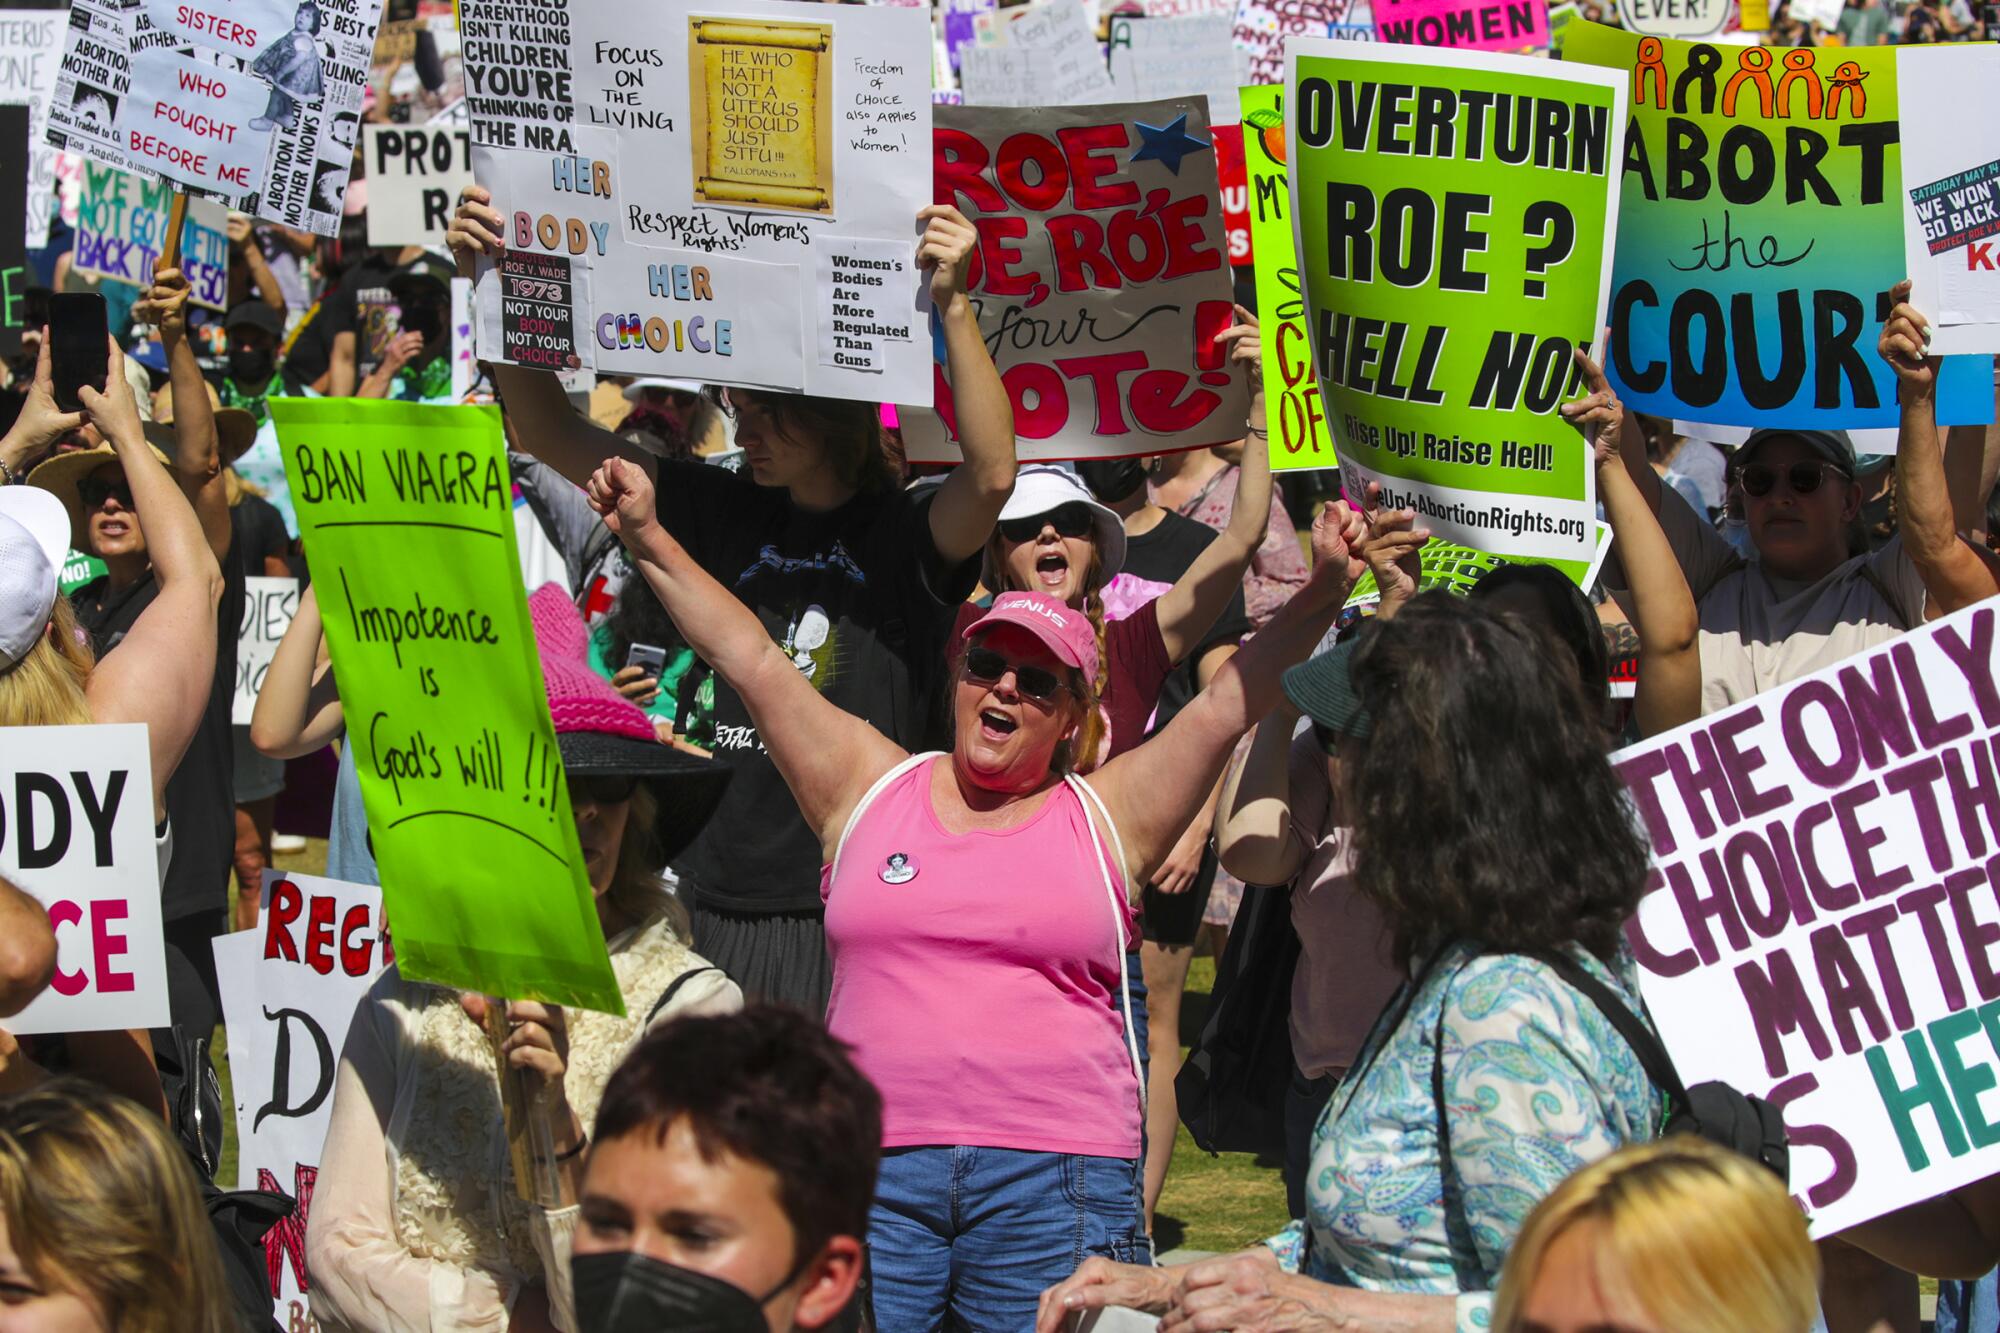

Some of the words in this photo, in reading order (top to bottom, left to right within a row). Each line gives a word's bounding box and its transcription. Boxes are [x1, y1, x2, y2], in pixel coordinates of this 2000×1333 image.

[177, 6, 257, 48] SISTERS
[333, 15, 365, 38] BEST
[461, 3, 570, 27] PARENTHOOD
[1381, 2, 1535, 47] WOMEN
[462, 21, 503, 39] ISN'T
[509, 25, 571, 46] KILLING
[464, 41, 573, 71] CHILDREN.
[722, 50, 747, 65] HE
[750, 51, 793, 68] WHO
[854, 57, 904, 76] Freedom
[61, 54, 109, 86] MOTHER
[615, 68, 644, 87] ON
[722, 67, 773, 82] HATH
[178, 68, 226, 99] WHO
[466, 65, 573, 103] YOU'RE
[722, 82, 761, 98] NOT
[764, 86, 777, 99] A
[870, 78, 884, 90] of
[468, 97, 549, 122] THINKING
[553, 106, 574, 123] OF
[601, 89, 643, 106] THE
[722, 98, 799, 117] UTERUS
[856, 93, 902, 105] CHOICE
[74, 116, 100, 136] Traded
[101, 127, 110, 138] to
[154, 102, 237, 144] FOUGHT
[589, 106, 674, 132] LIVING
[722, 114, 799, 132] SHOULD
[846, 112, 870, 121] also
[1298, 77, 1609, 177] OVERTURN
[295, 115, 320, 167] KNOWS
[473, 120, 517, 147] THE
[524, 126, 578, 154] NRA.
[722, 130, 770, 147] JUST
[863, 126, 878, 136] to
[88, 145, 124, 165] Angeles
[130, 131, 208, 175] BEFORE
[217, 164, 250, 188] ME
[723, 146, 772, 163] STFU
[1622, 115, 1899, 206] ABORT
[84, 159, 129, 199] WE
[267, 140, 295, 211] ABORTION
[552, 157, 613, 200] HER
[1911, 176, 1961, 202] SATURDAY
[1964, 167, 1985, 183] MAY
[1988, 161, 1999, 175] 14
[284, 172, 309, 226] MOTHER
[1915, 197, 1945, 222] WE
[79, 191, 127, 238] NOT
[130, 206, 155, 247] GO
[628, 204, 719, 240] Respect
[727, 211, 810, 246] Women's
[1922, 218, 1948, 241] GO
[514, 211, 610, 256] BODY
[682, 231, 747, 252] Rights!
[1327, 181, 1493, 294] ROE
[1523, 200, 1577, 300] ?
[1668, 209, 1815, 272] the
[1929, 233, 1966, 252] PROTECT
[1968, 226, 1985, 240] ROE
[75, 229, 131, 280] BACK
[512, 251, 558, 265] PROTECT
[831, 255, 903, 272] Women's
[505, 260, 525, 274] ROE
[527, 264, 538, 277] V.
[538, 266, 568, 281] WADE
[647, 263, 713, 301] HER
[832, 271, 883, 286] Bodies
[510, 278, 563, 302] 1973
[832, 287, 860, 301] Are
[505, 300, 532, 317] NOT
[535, 304, 569, 322] YOUR
[832, 303, 875, 318] More
[519, 316, 556, 335] BODY
[596, 311, 734, 356] CHOICE
[833, 320, 909, 338] Regulated
[506, 330, 533, 347] NOT
[536, 335, 570, 351] YOUR
[833, 335, 873, 351] Than
[512, 346, 563, 366] CHOICE
[833, 352, 871, 367] Guns
[1320, 308, 1449, 406] HELL
[1280, 388, 1323, 454] OF
[1344, 414, 1380, 449] Rise
[1385, 425, 1417, 457] Up!
[1423, 433, 1492, 466] Raise
[1500, 440, 1553, 471] Hell!
[297, 444, 366, 504] BAN
[382, 445, 507, 512] VIAGRA
[61, 560, 91, 584] NO!
[339, 566, 499, 668] Impotence
[1000, 598, 1069, 629] VENUS
[1615, 705, 1794, 858] THE
[1781, 608, 2000, 789] ONLY
[369, 712, 442, 806] God's
[522, 731, 561, 823] !!!
[1625, 780, 1914, 978] CHOICE
[1733, 854, 2000, 1079] MATTE
